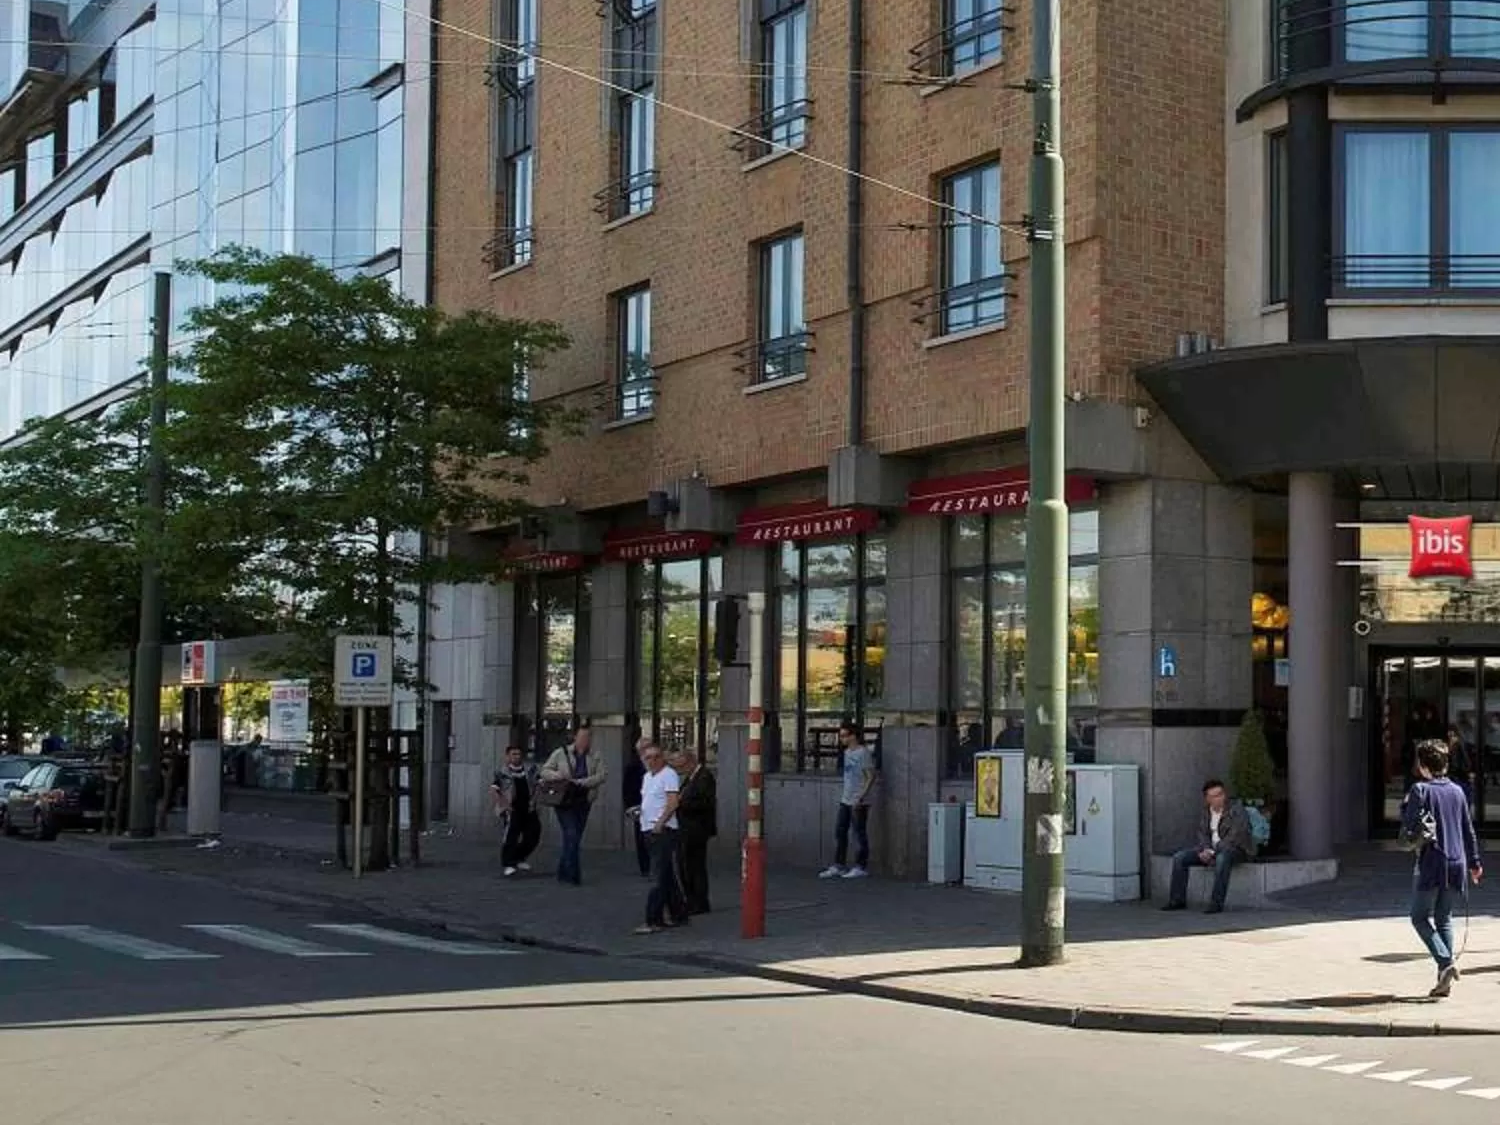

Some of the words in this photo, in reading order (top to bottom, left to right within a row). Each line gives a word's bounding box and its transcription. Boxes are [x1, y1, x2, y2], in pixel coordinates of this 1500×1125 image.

[929, 490, 1031, 513] RESTAURA
[753, 516, 854, 540] RESTAURANT
[1418, 528, 1464, 554] ibis
